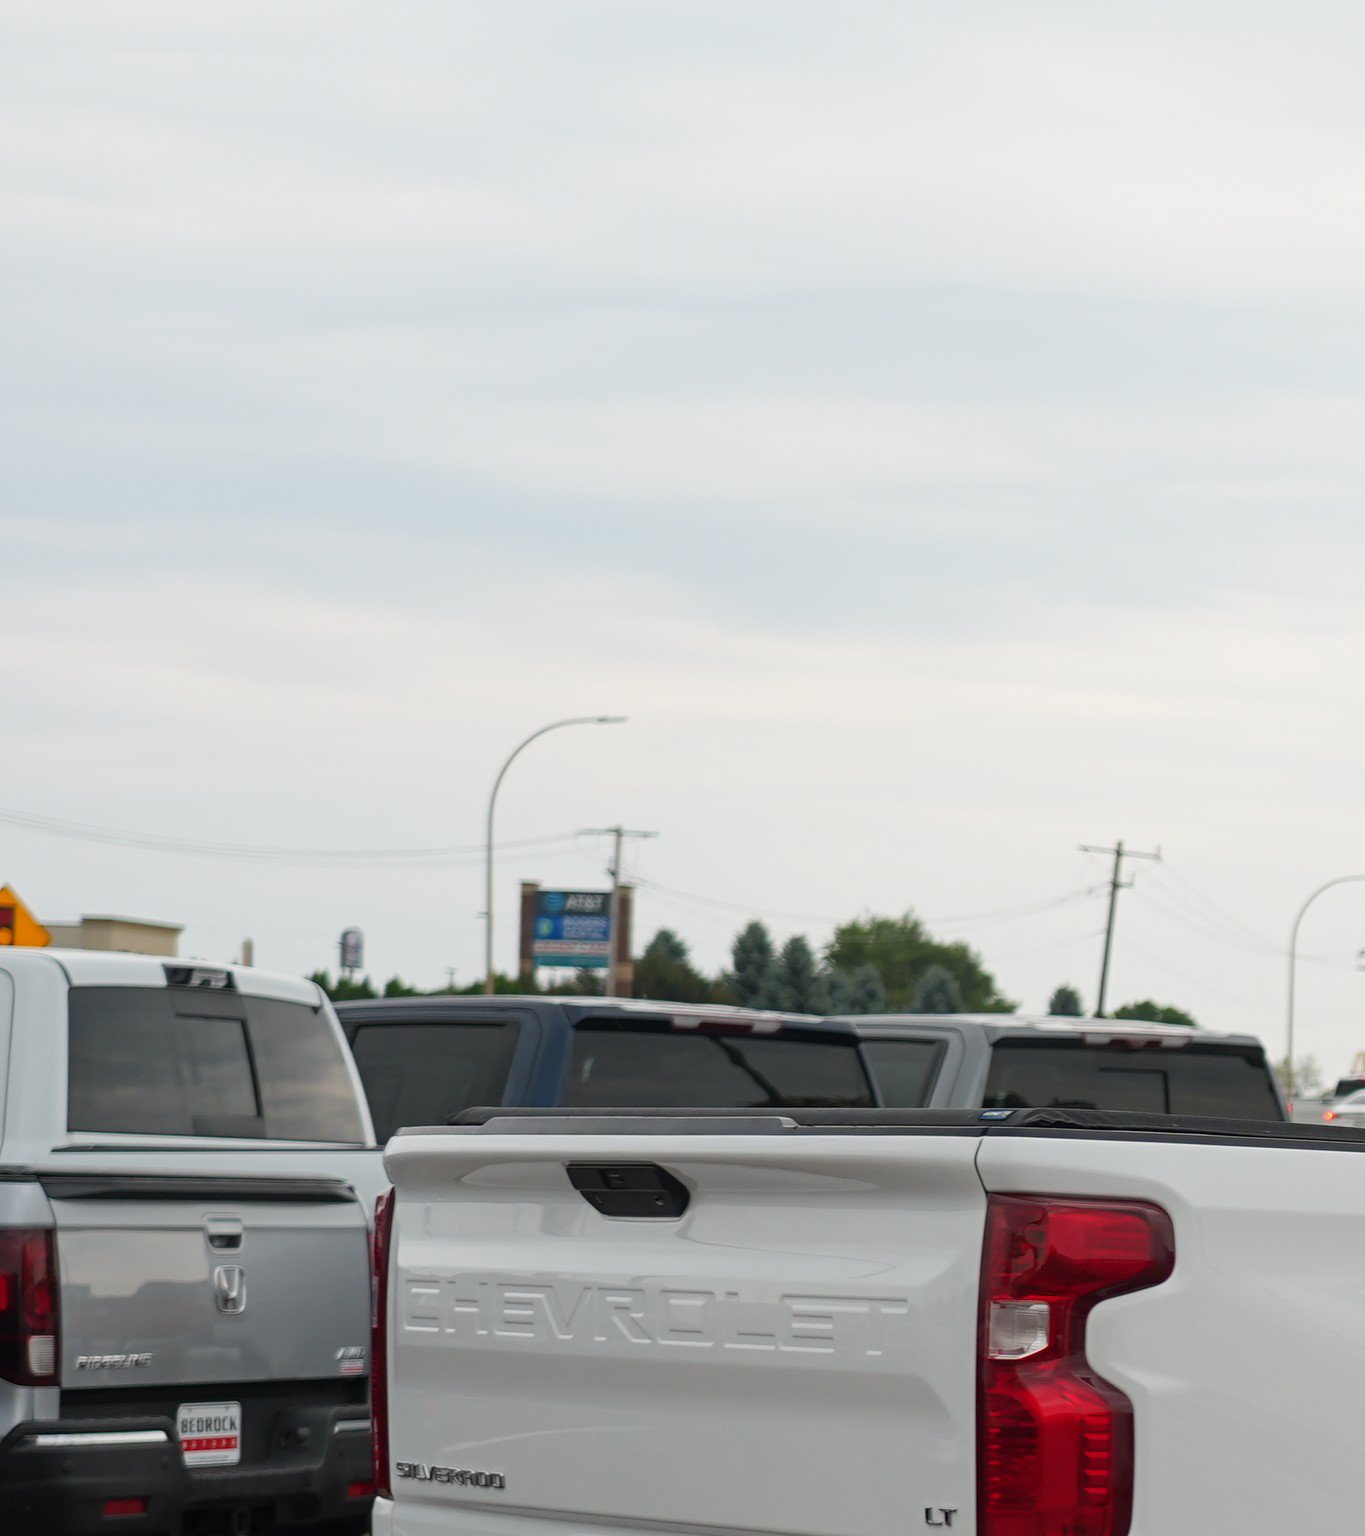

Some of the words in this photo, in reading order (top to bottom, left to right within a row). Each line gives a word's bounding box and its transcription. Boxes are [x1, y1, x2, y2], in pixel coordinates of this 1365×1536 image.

[565, 894, 605, 910] AT&T
[404, 1279, 908, 1355] CHEVROLET
[181, 1416, 237, 1434] BEDROCK
[396, 1461, 506, 1489] SILVERADO
[925, 1507, 958, 1528] LT
